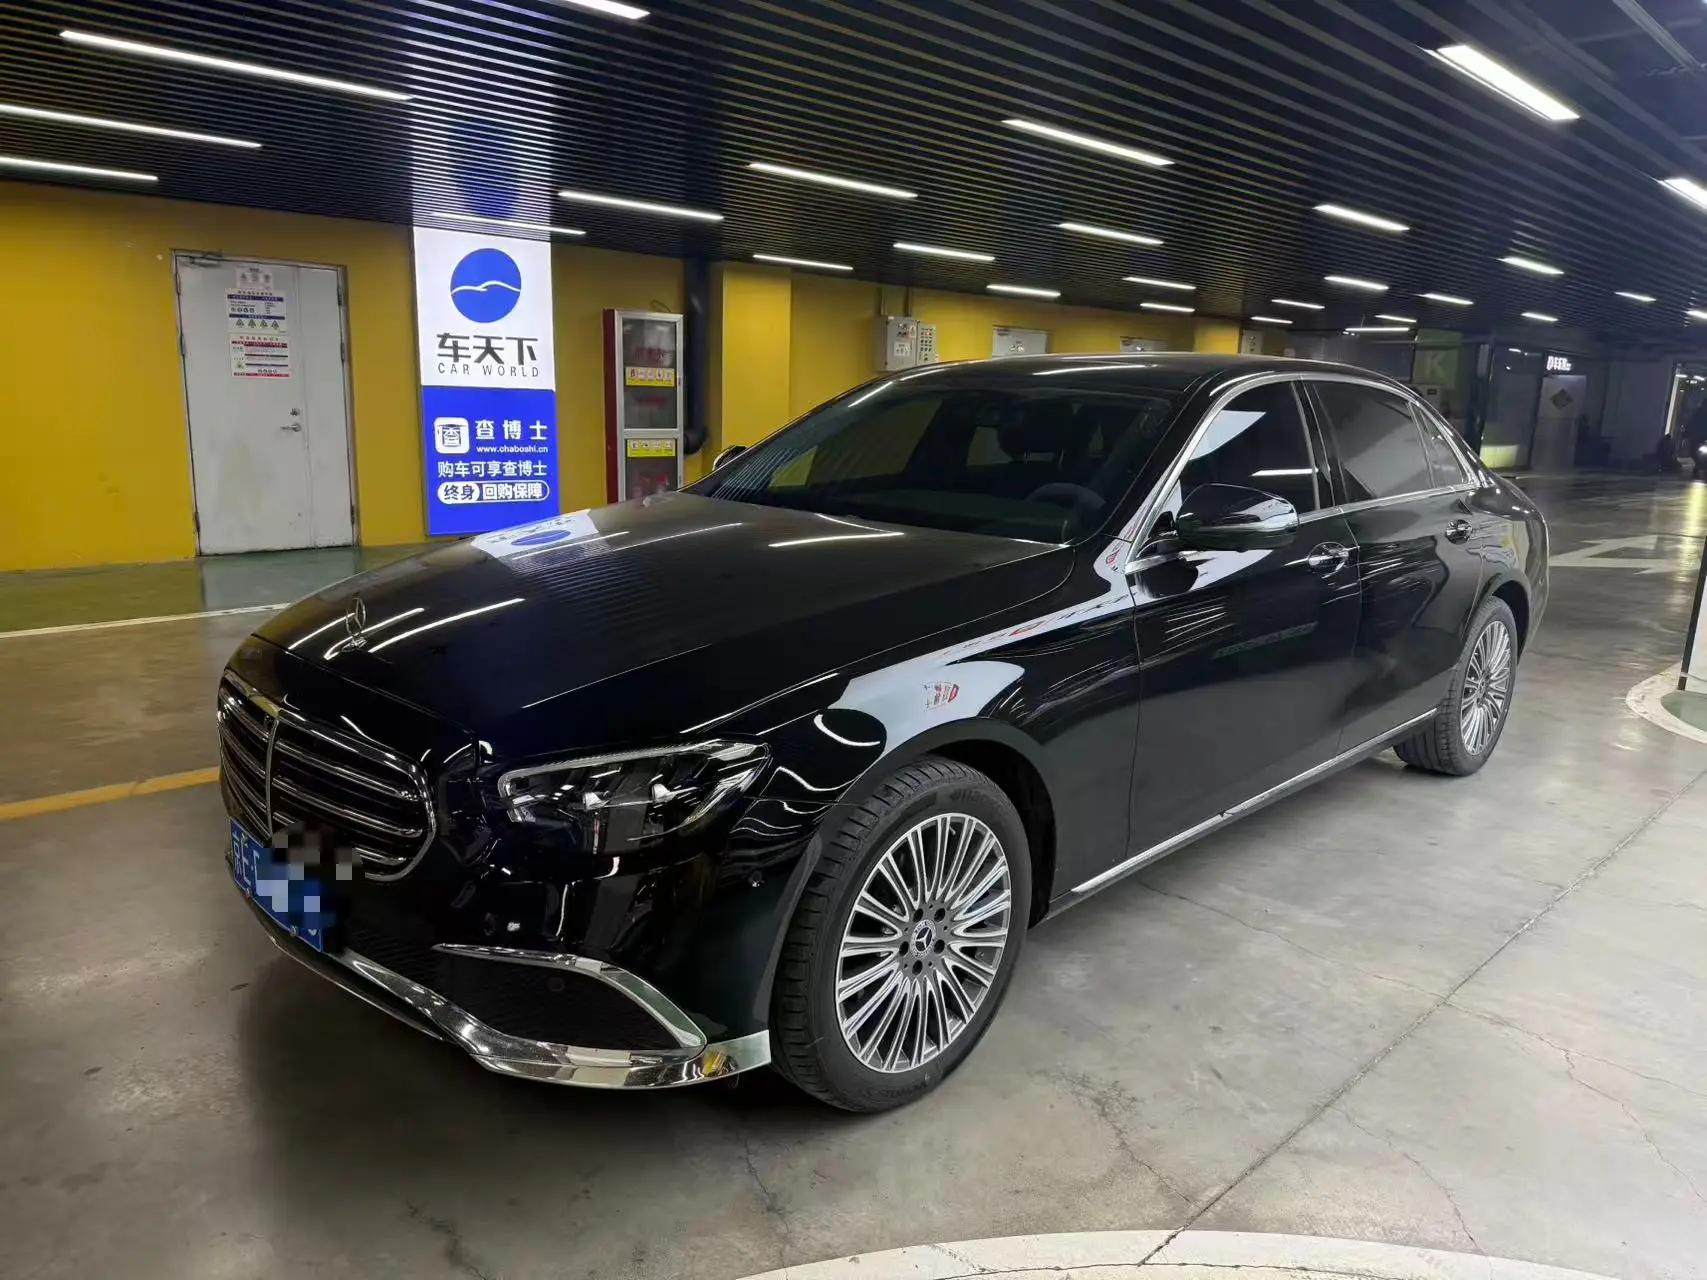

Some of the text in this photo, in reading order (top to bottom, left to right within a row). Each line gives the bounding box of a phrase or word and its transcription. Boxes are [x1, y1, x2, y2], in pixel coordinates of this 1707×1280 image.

[437, 333, 538, 366] 车天下
[438, 362, 539, 377] CAR WORLD
[475, 419, 548, 440] 查博士
[476, 445, 549, 453] www.chaboshi.cn
[437, 461, 547, 478] 购车可享查博士
[444, 482, 543, 501] 终身 回购保障
